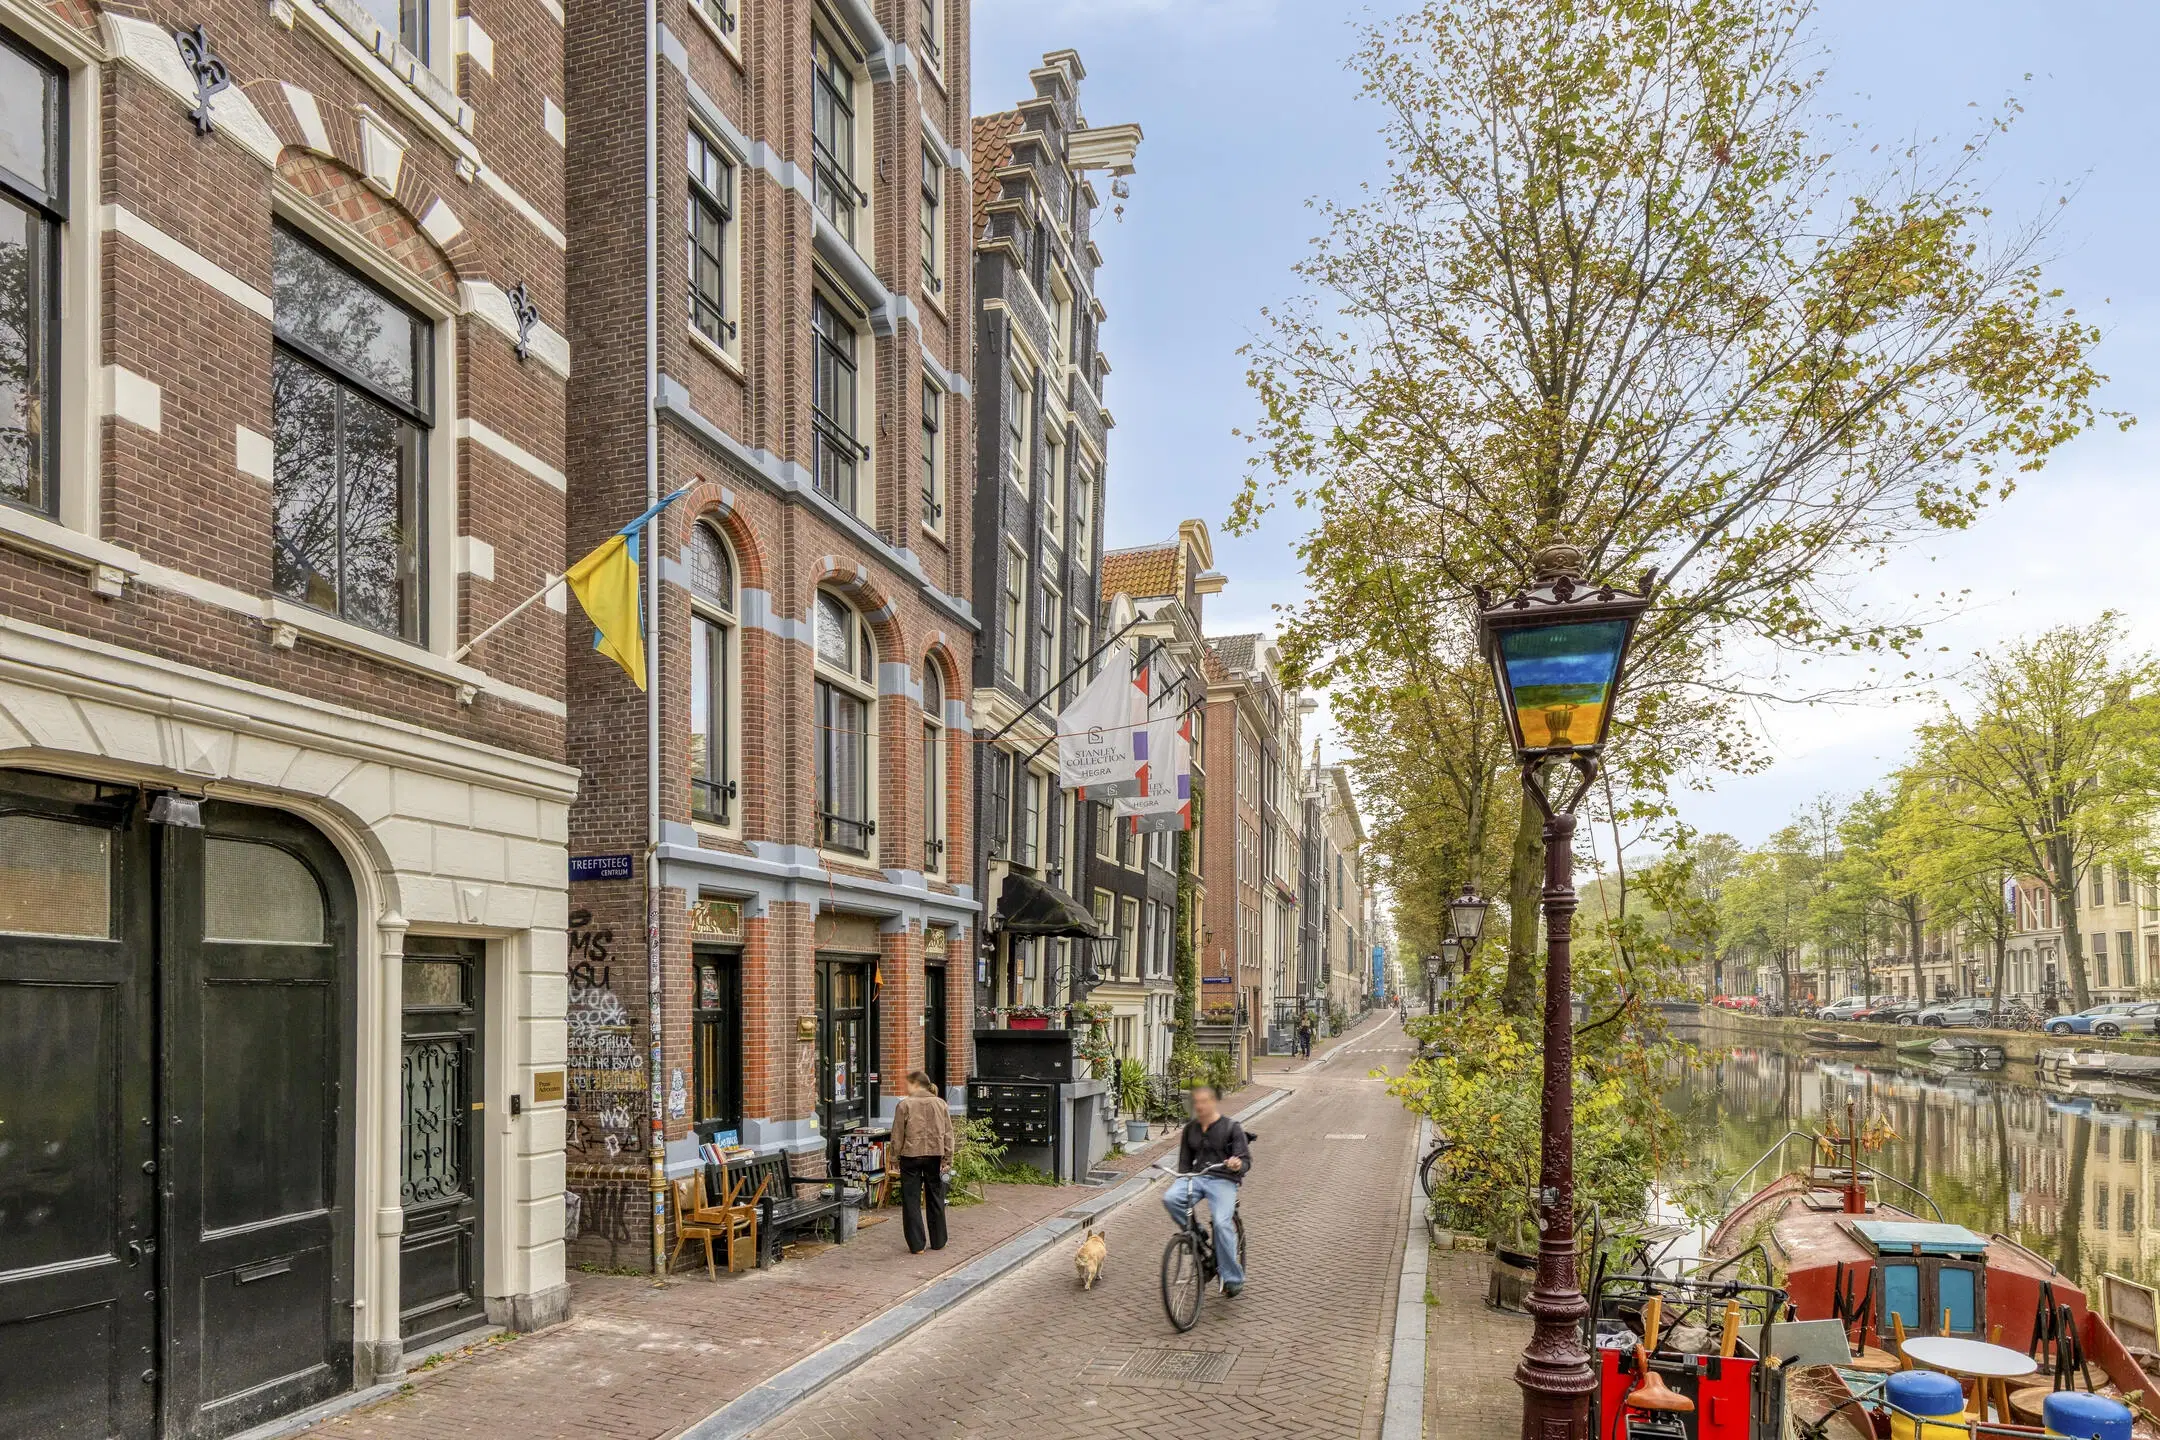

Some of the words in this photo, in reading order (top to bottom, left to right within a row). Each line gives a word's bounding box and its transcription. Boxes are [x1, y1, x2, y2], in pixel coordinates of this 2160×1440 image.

[1075, 746, 1118, 759] STANLEY
[1066, 753, 1127, 767] COLLECTION
[1081, 767, 1112, 777] HEGRA
[1133, 800, 1160, 809] HEGRA
[571, 857, 628, 870] TREEFTSTEEG
[601, 869, 629, 877] CENTRUM
